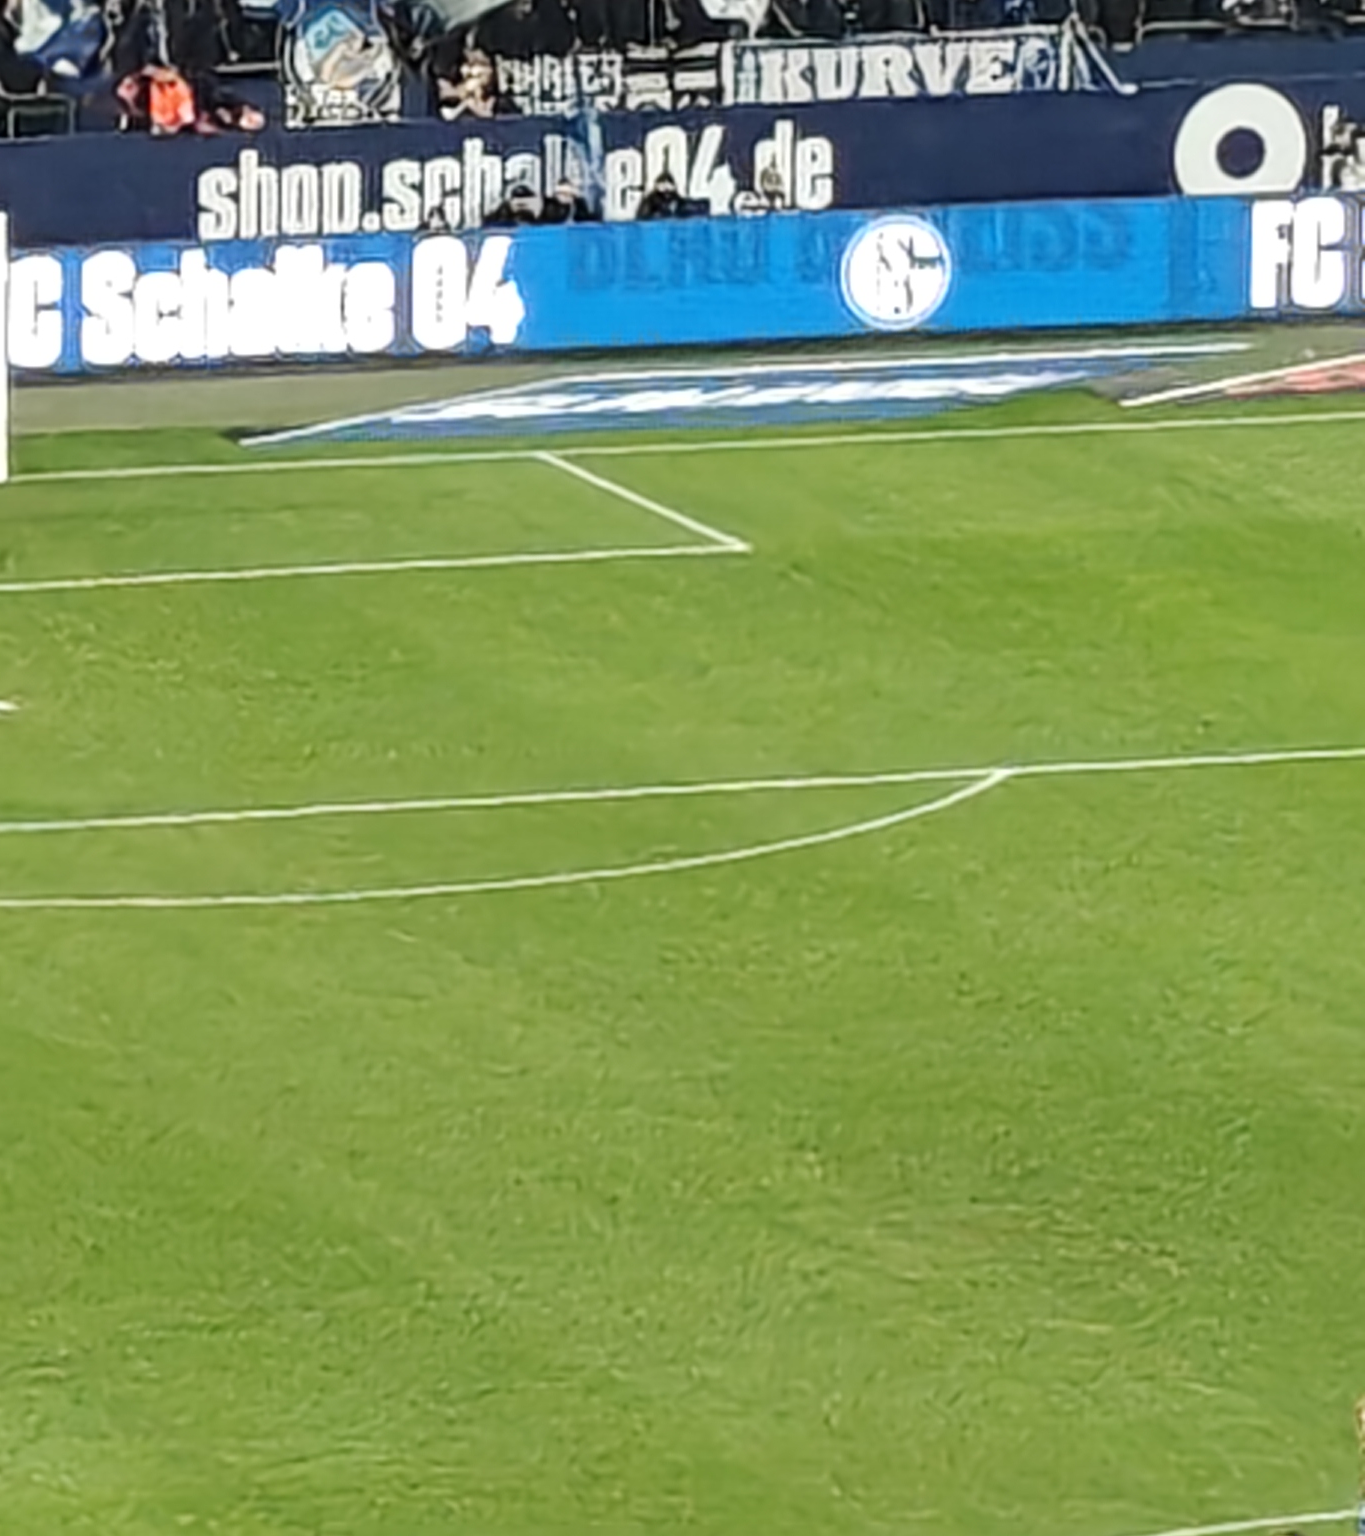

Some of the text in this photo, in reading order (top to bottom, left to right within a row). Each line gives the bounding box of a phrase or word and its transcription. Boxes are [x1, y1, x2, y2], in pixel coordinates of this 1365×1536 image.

[758, 40, 1018, 103] KURVE
[198, 119, 834, 241] shop.schale04.de
[81, 244, 394, 364] Schalke
[412, 236, 526, 351] 04
[1250, 197, 1345, 309] FC
